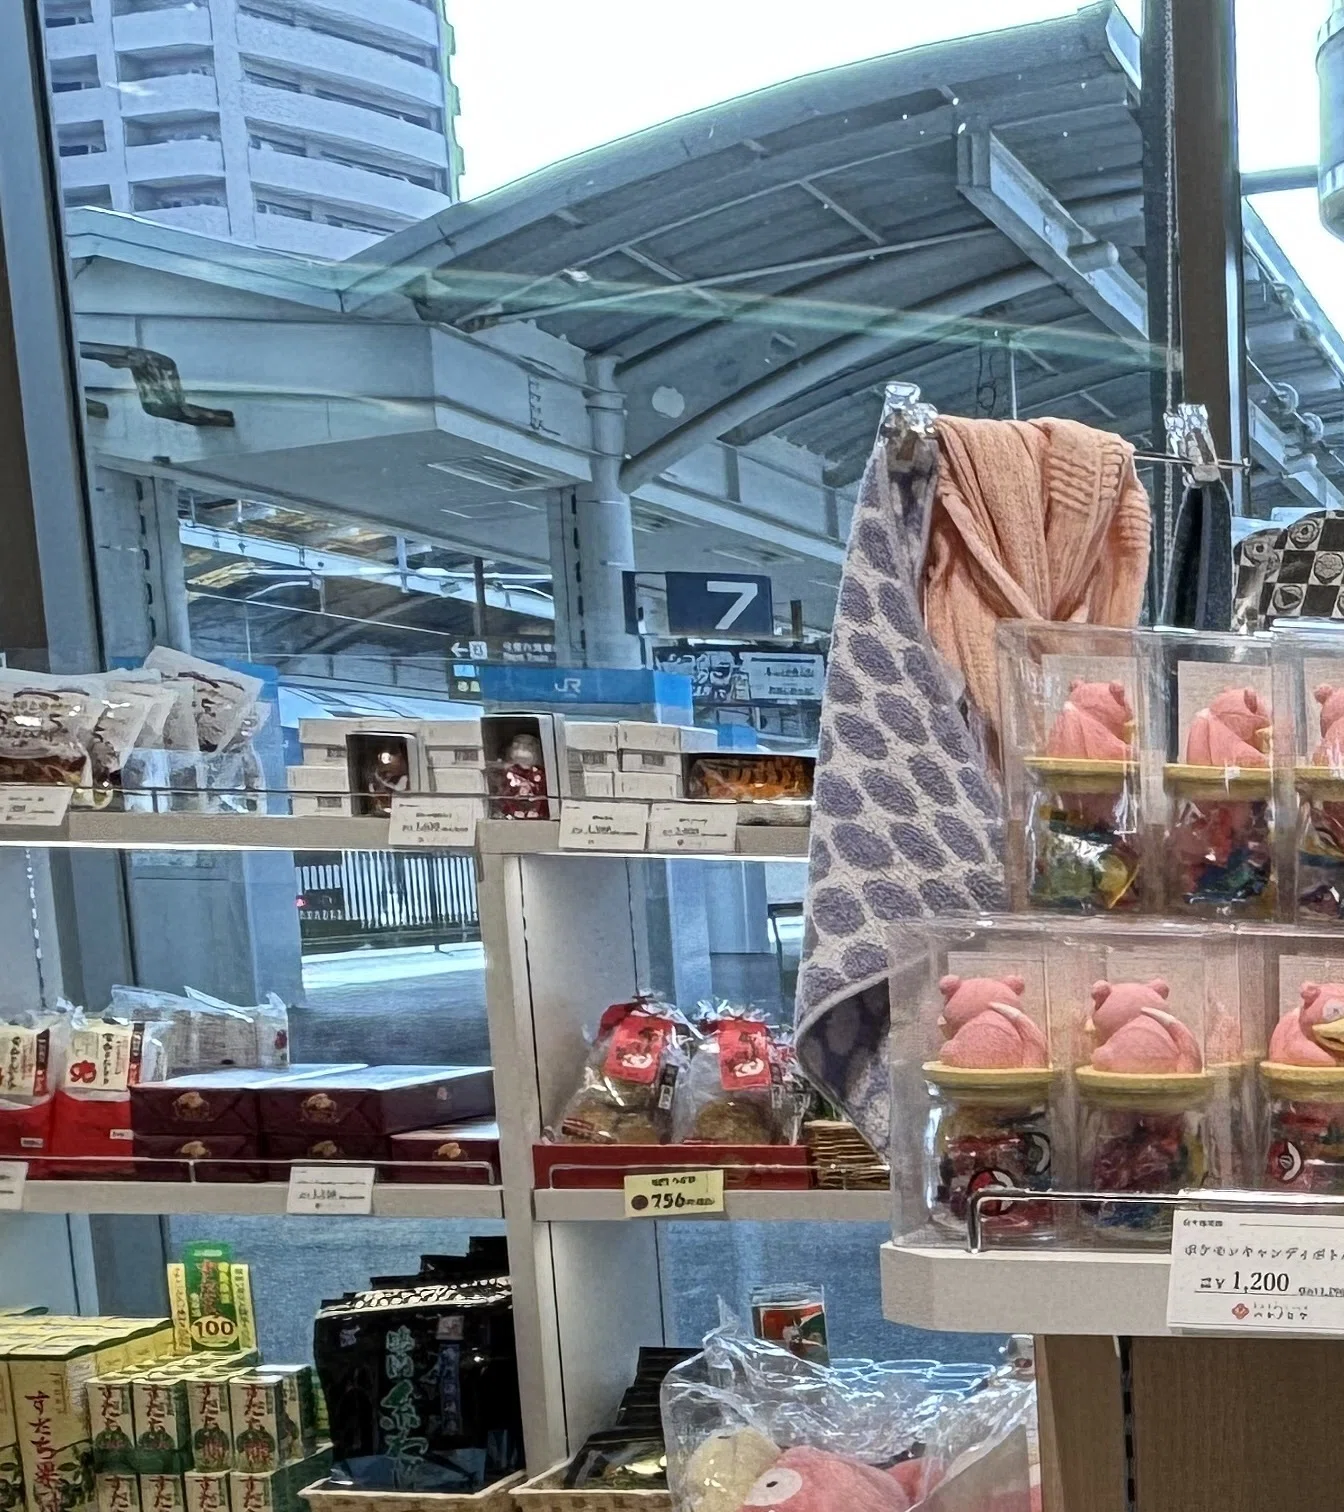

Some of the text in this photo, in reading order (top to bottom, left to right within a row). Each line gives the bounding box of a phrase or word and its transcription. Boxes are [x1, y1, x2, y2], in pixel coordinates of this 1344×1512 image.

[706, 580, 759, 630] 7
[554, 677, 582, 694] JR
[1231, 1270, 1291, 1294] 1,200
[195, 1320, 235, 1337] 100
